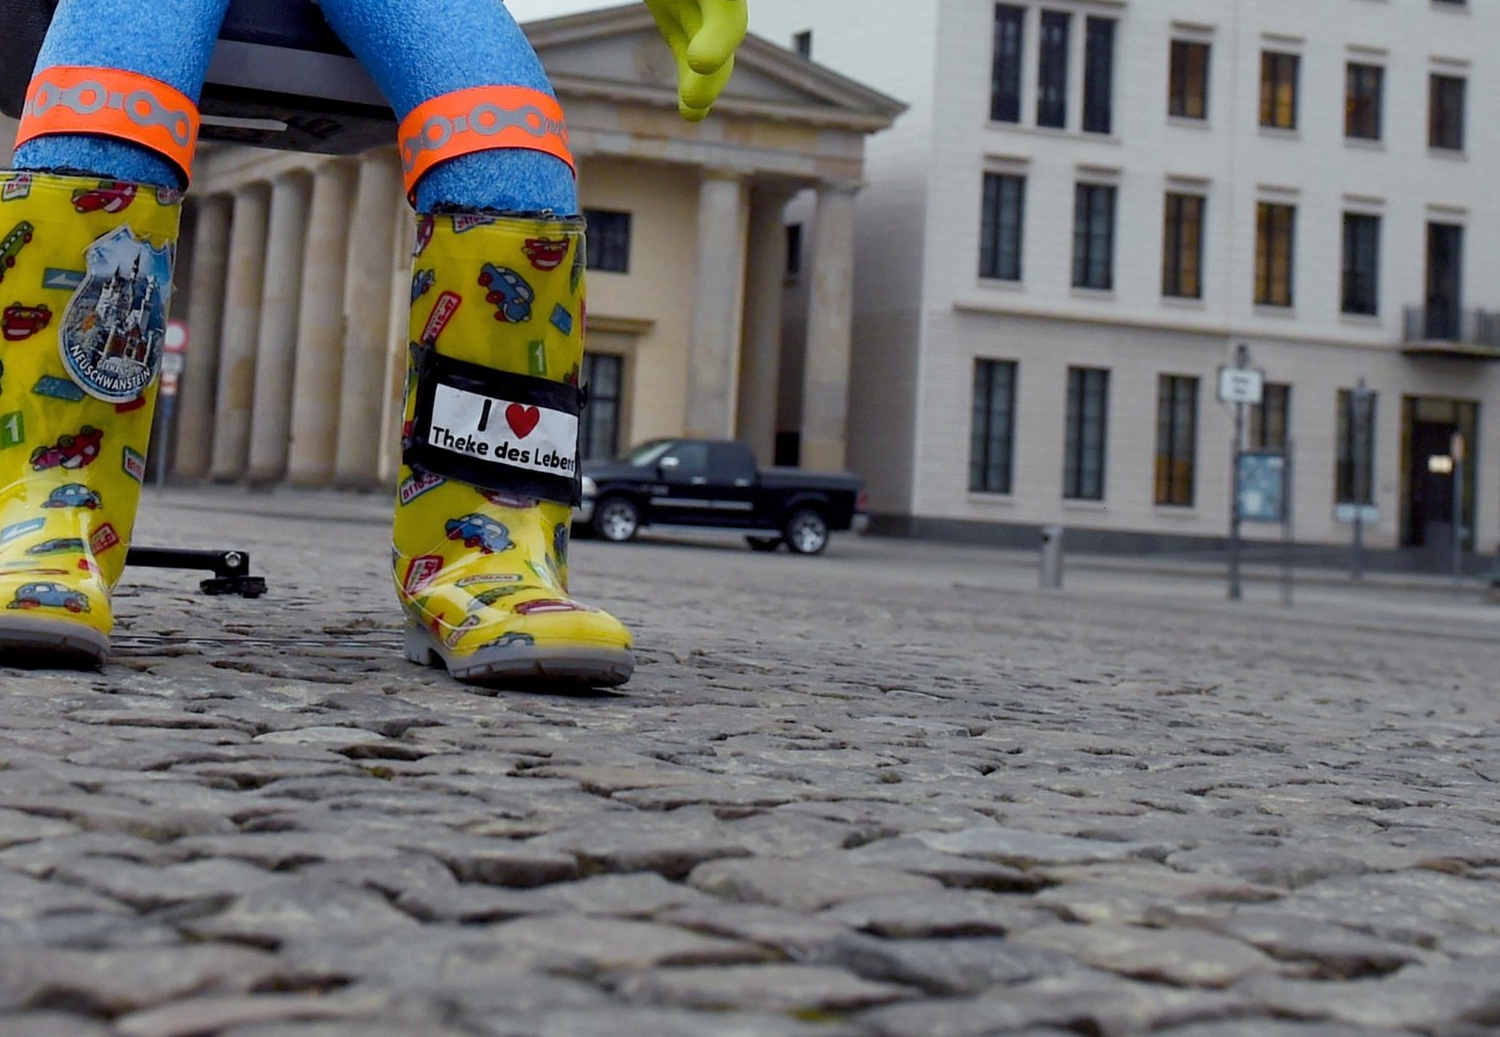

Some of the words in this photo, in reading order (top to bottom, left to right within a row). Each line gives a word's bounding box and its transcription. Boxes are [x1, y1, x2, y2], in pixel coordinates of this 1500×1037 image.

[70, 344, 151, 390] NEUSCHWANSTEIN
[477, 399, 492, 432] I
[433, 426, 489, 455] Theke
[494, 441, 530, 463] des
